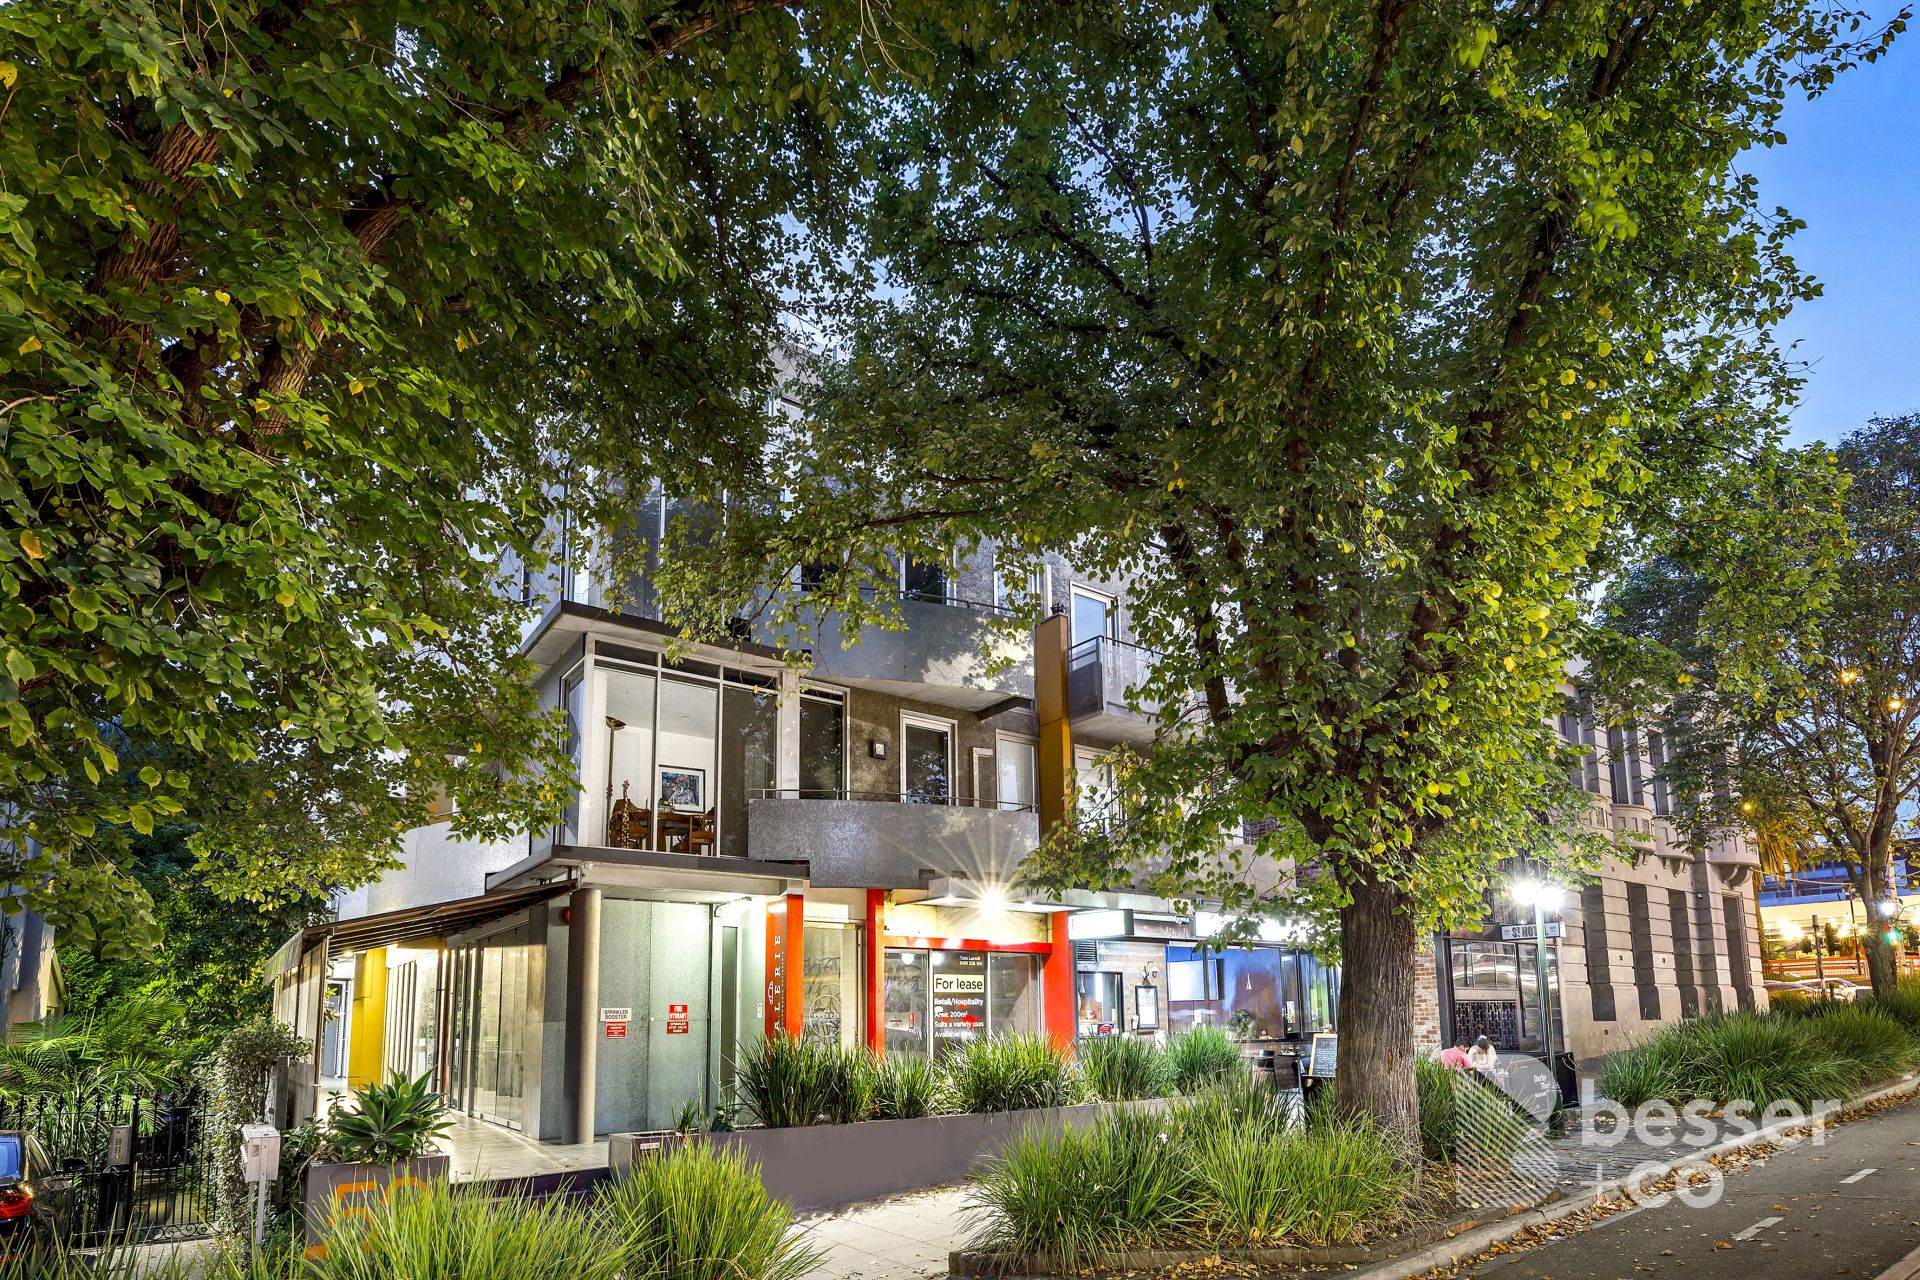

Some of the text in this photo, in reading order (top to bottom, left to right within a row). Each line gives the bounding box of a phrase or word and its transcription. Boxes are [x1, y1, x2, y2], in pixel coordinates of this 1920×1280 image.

[1522, 926, 1549, 937] HOTL
[936, 977, 983, 989] For lease
[934, 998, 984, 1006] Retail/Hospitality
